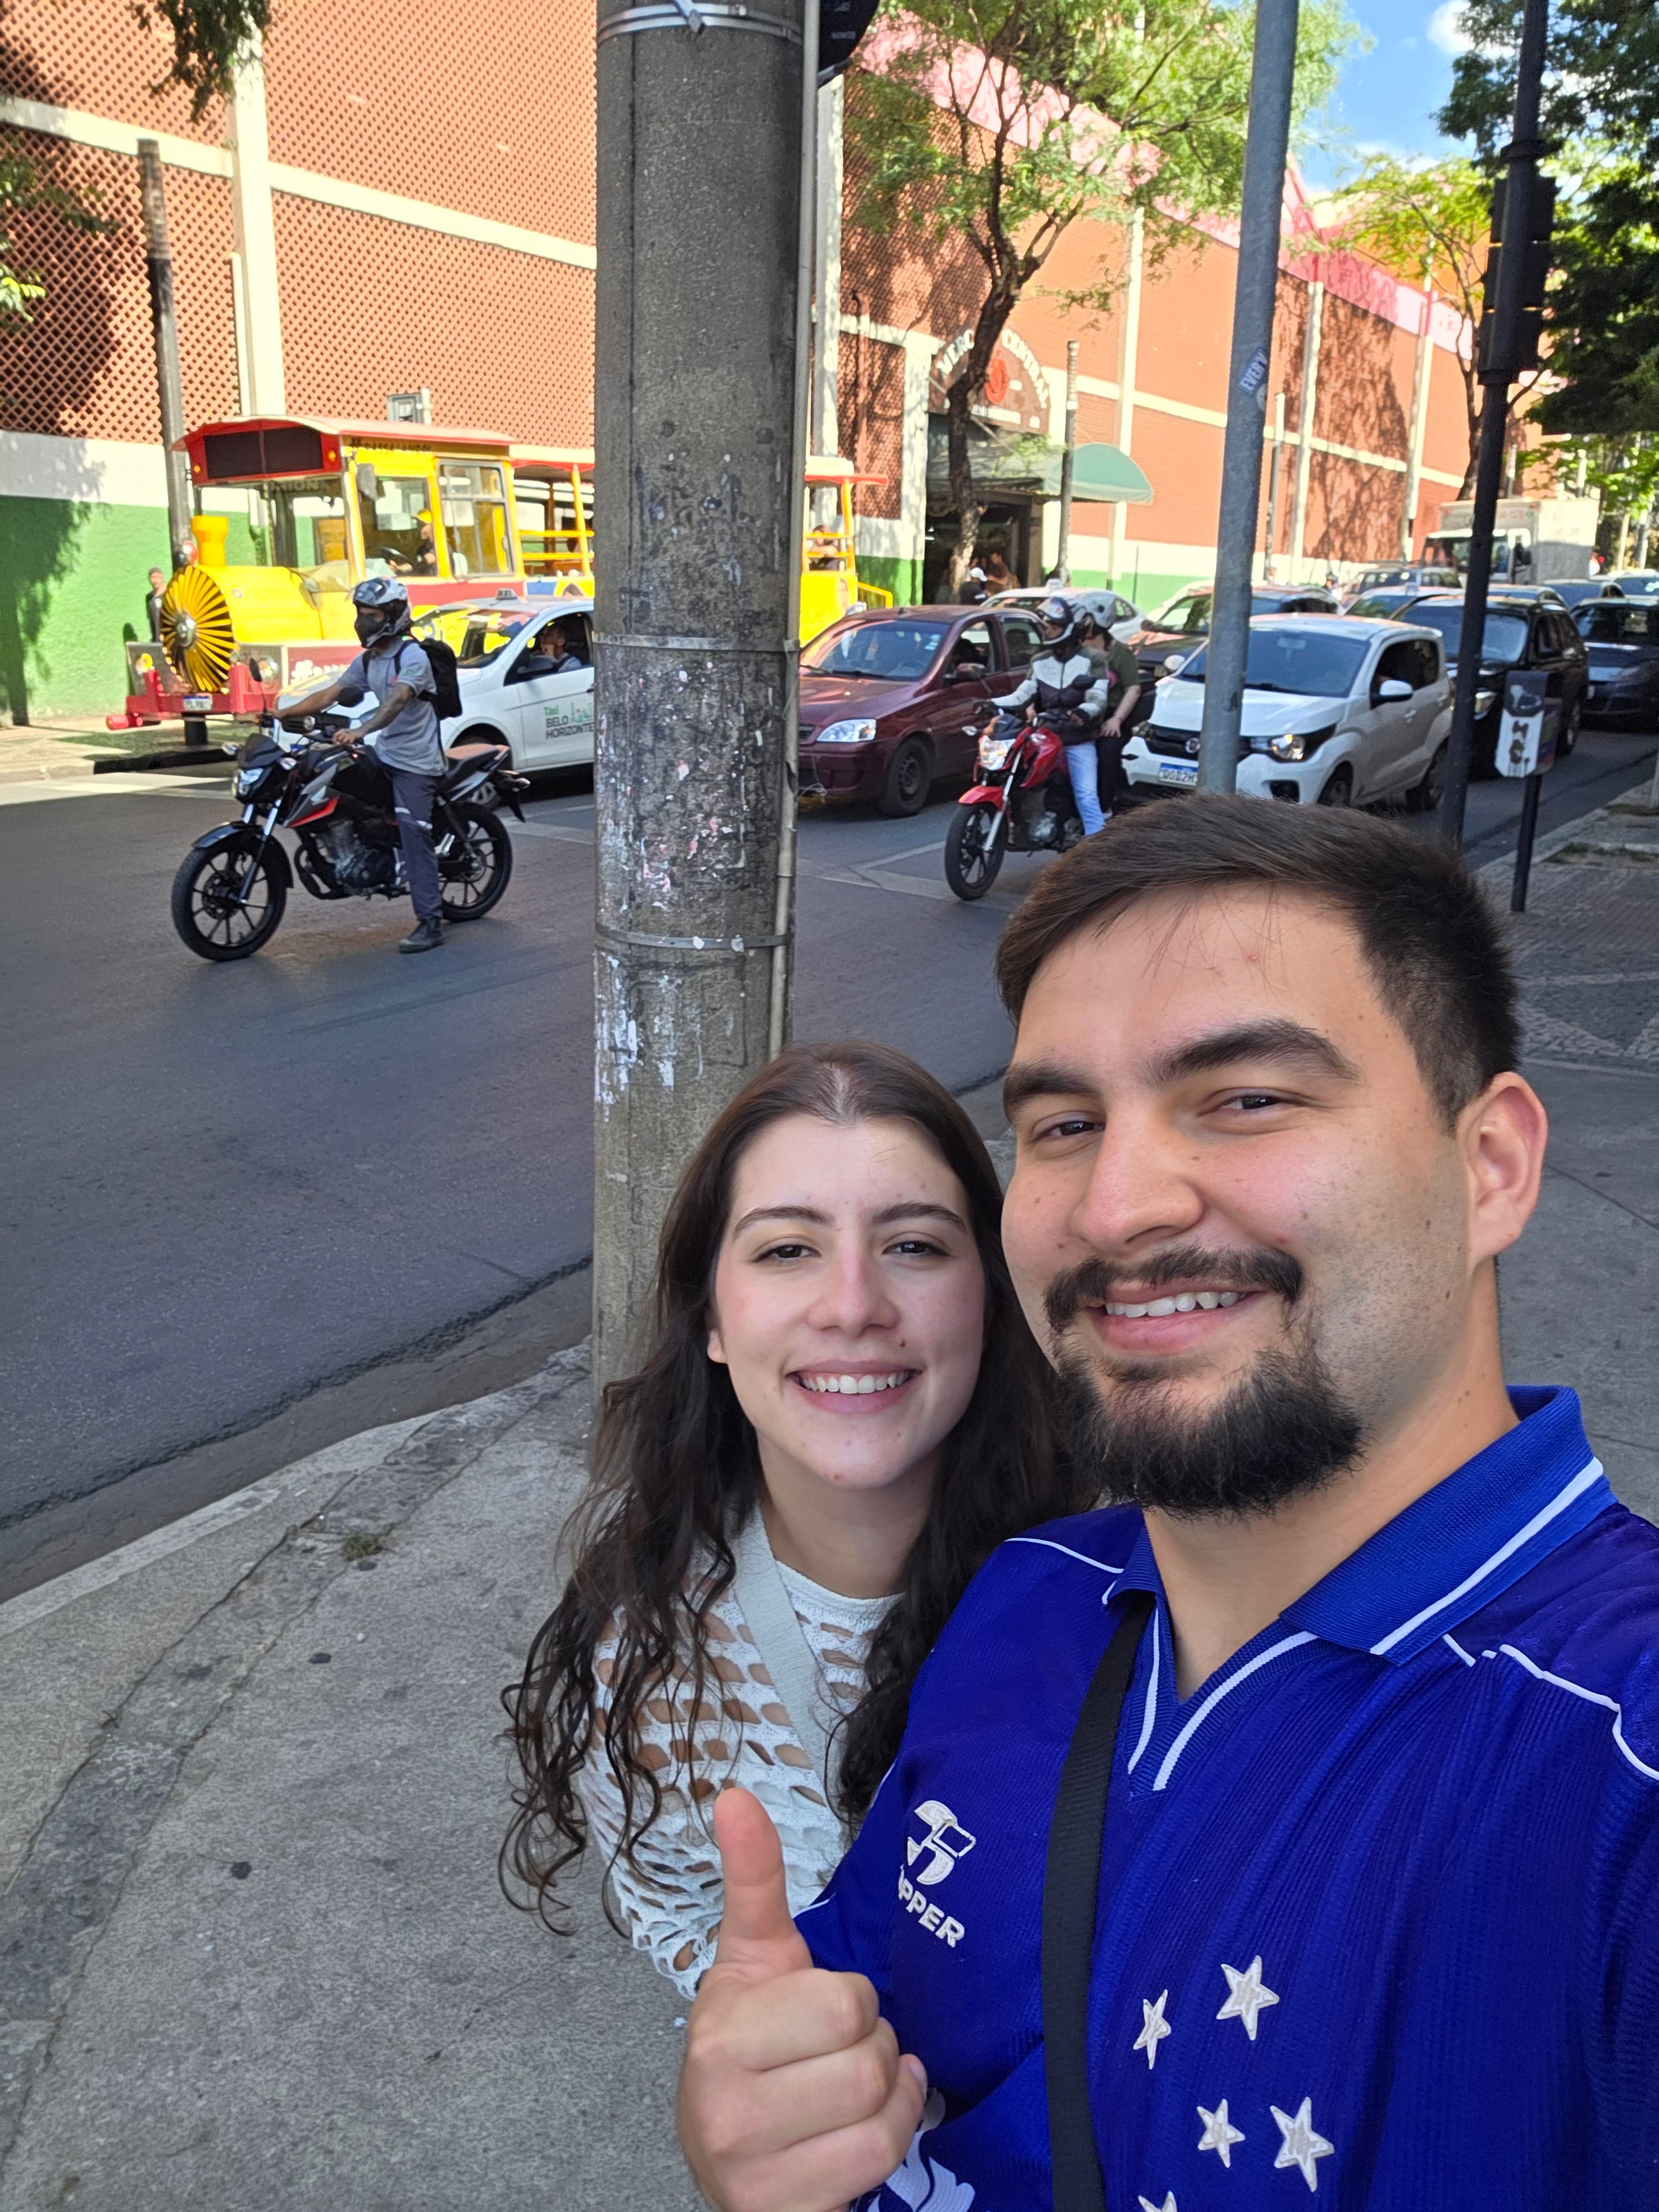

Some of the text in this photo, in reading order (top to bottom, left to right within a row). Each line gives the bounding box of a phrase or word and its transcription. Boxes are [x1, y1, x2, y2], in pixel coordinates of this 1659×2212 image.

[936, 328, 1049, 409] MERC CENTRAL
[545, 721, 594, 739] HORIZONTE
[546, 715, 568, 728] BELO
[898, 1864, 965, 1948] PPER
